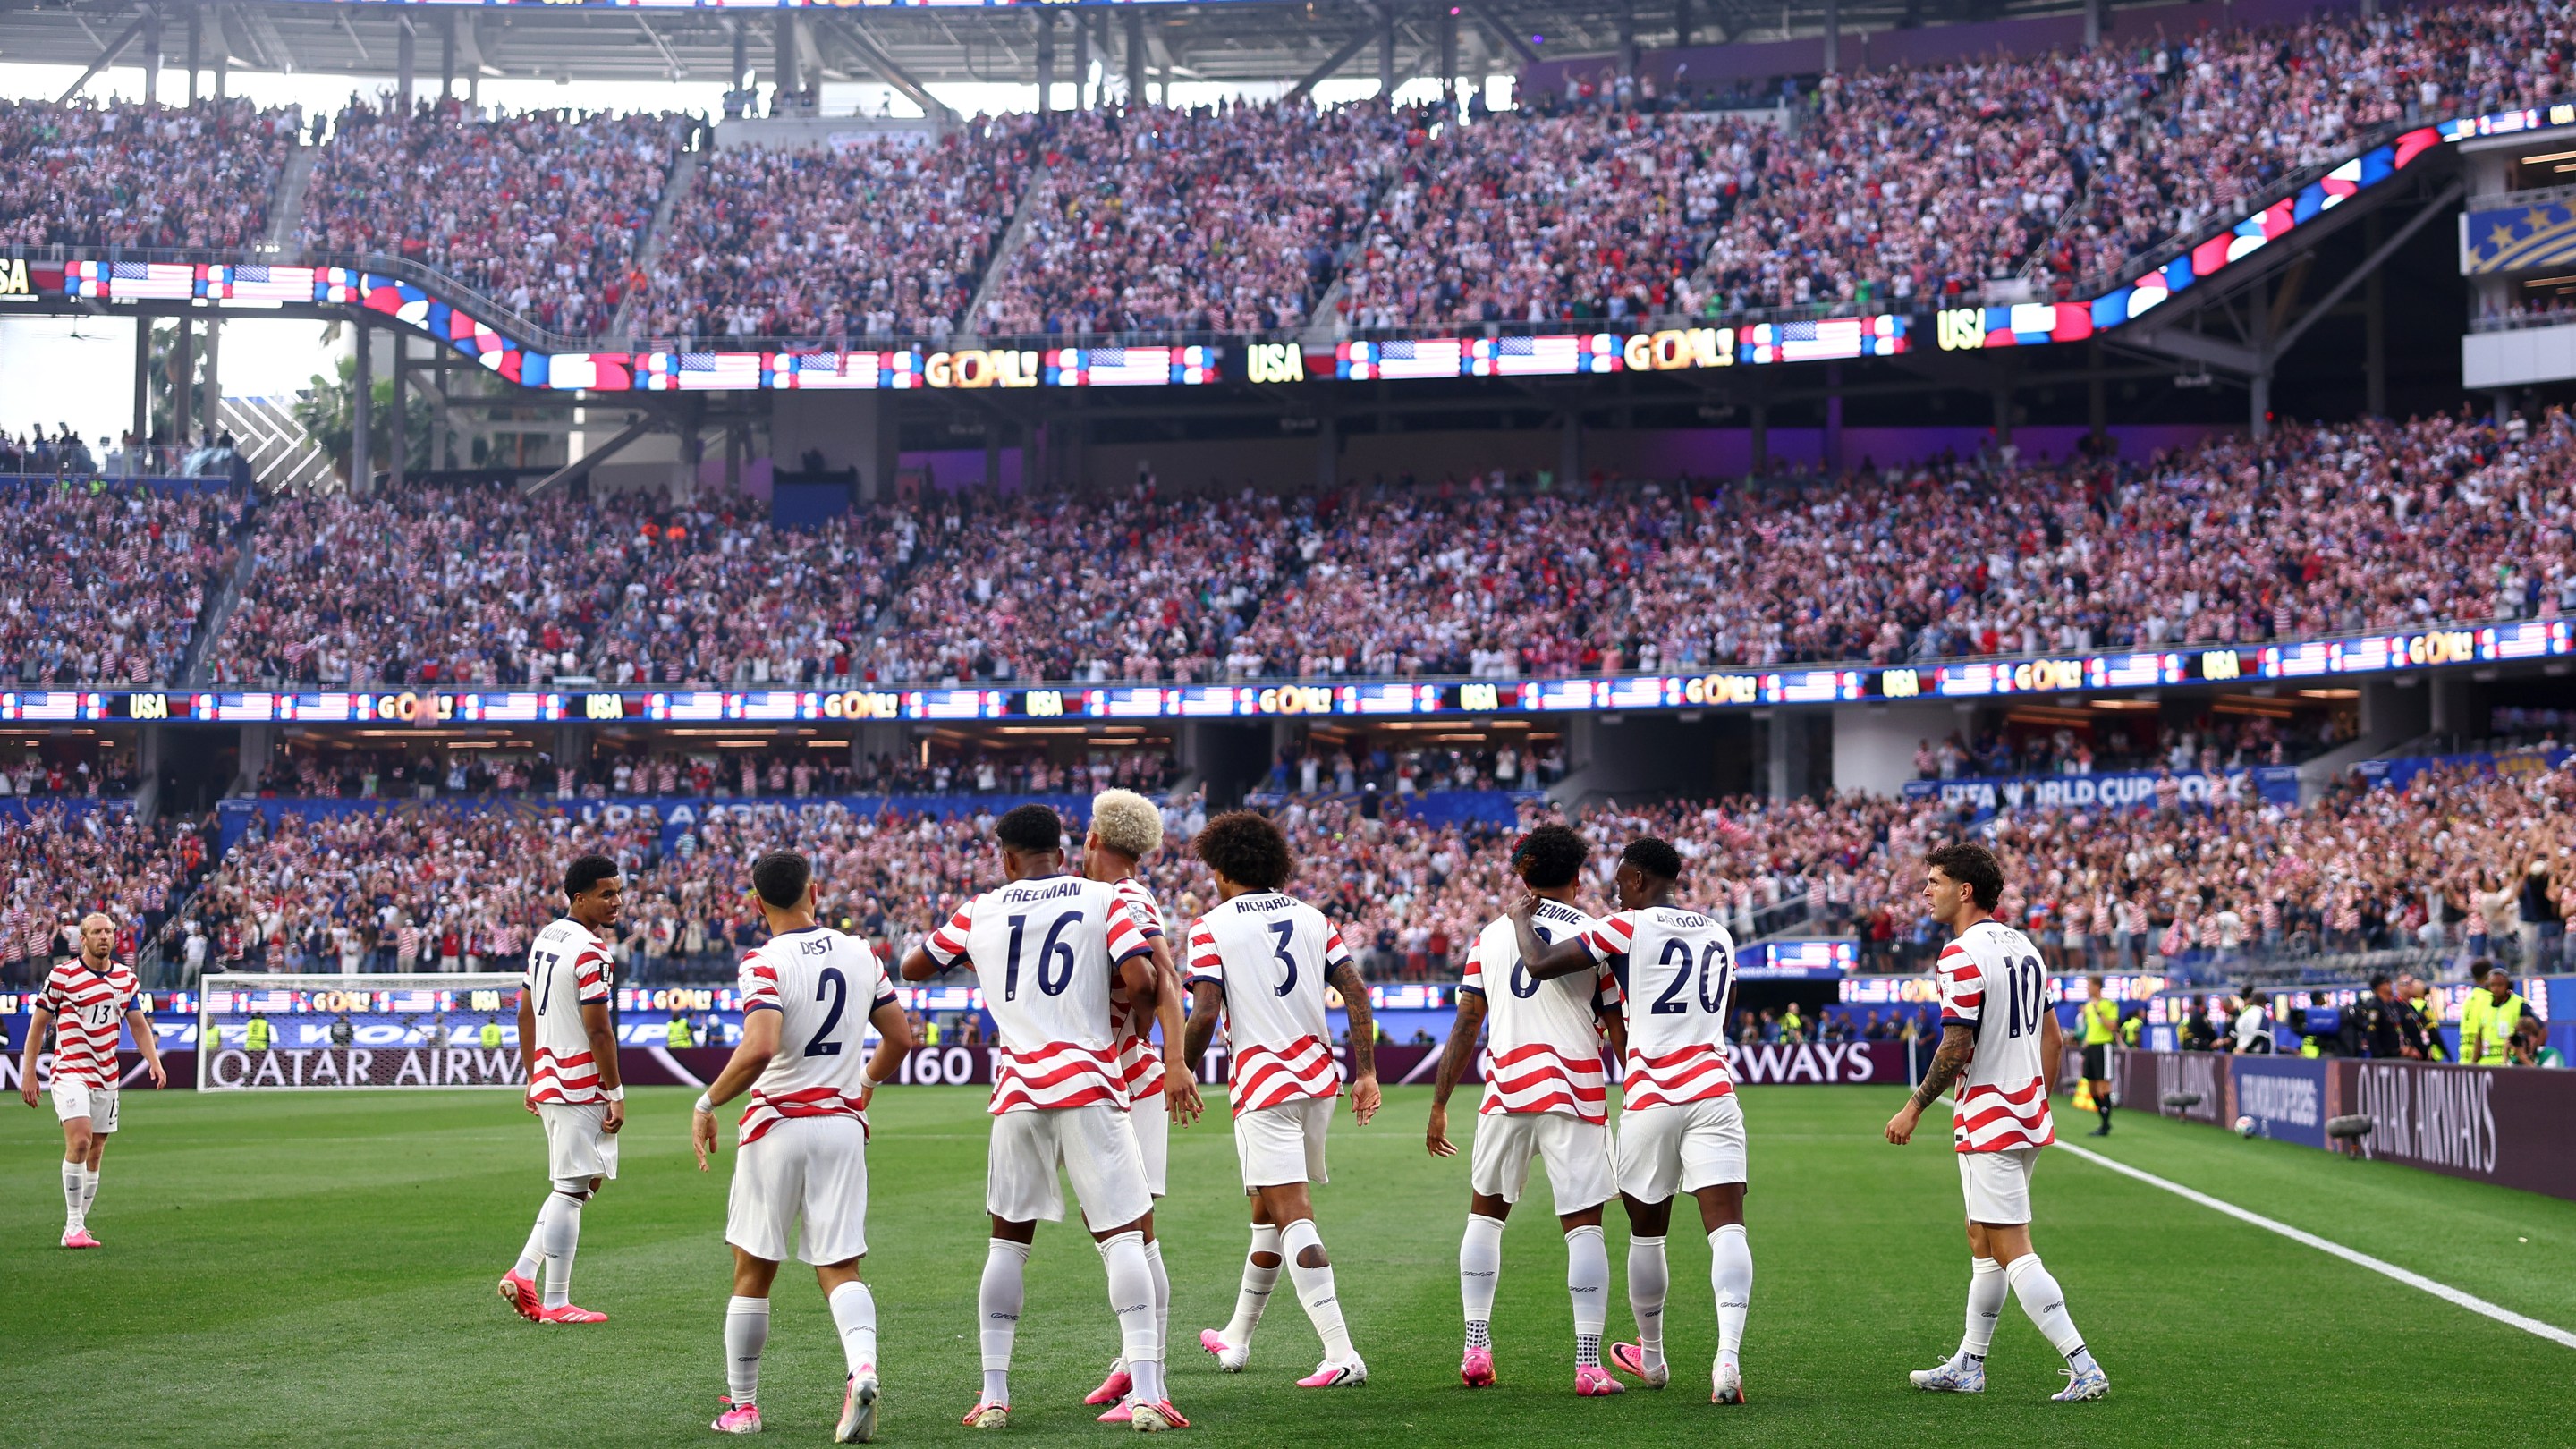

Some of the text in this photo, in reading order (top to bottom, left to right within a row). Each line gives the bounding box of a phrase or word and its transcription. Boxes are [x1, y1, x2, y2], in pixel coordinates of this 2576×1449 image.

[924, 349, 1039, 388] GOAL!
[1247, 343, 1305, 384] USA
[1623, 327, 1735, 371] GOAL!
[130, 693, 169, 720] USA
[586, 693, 624, 720] USA
[1026, 691, 1063, 717] USA
[1460, 683, 1499, 712] USA
[1002, 882, 1082, 903] FREEMAN
[1235, 896, 1298, 913] RICHARDS
[800, 935, 833, 956] DEST
[1005, 910, 1085, 1003] 16
[1267, 919, 1298, 998] 3
[534, 950, 560, 1016] 17
[1651, 936, 1728, 1014] 20
[91, 1004, 111, 1024] 13
[803, 966, 847, 1058] 2
[2004, 954, 2043, 1039] 10
[211, 1047, 527, 1087] QATAR AIRW
[899, 1046, 974, 1086] 160
[1729, 1041, 1875, 1083] RWAYS
[2356, 1063, 2412, 1161] QATAR
[2415, 1067, 2497, 1174] AIRWAYS
